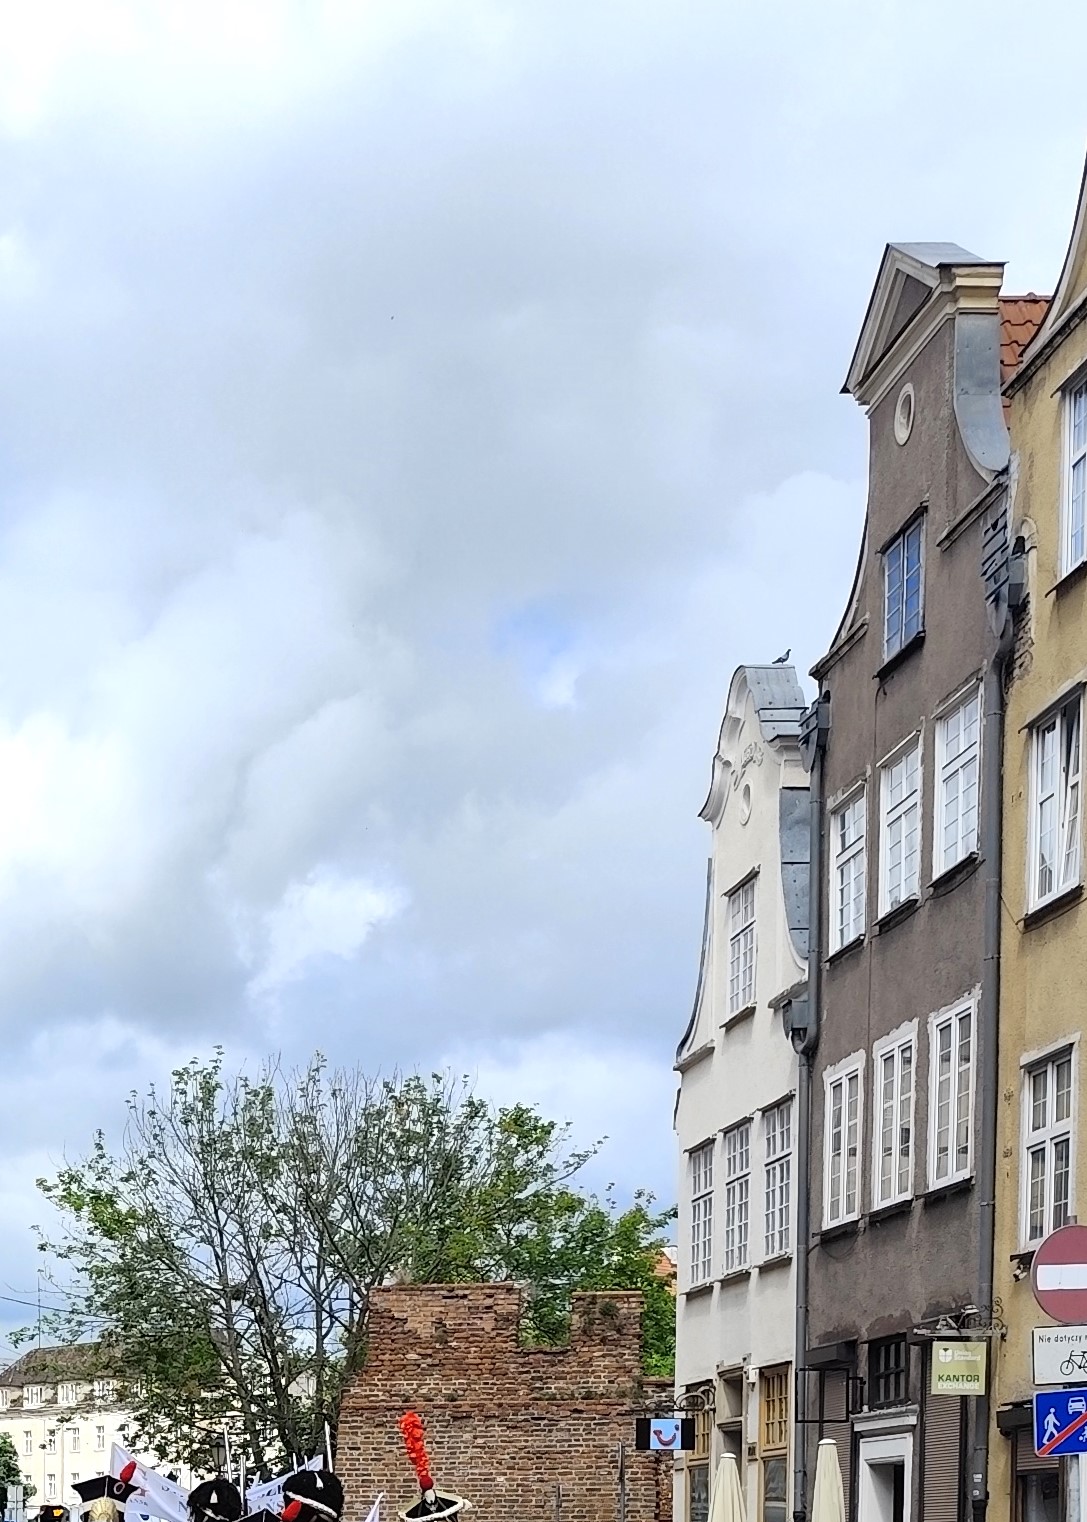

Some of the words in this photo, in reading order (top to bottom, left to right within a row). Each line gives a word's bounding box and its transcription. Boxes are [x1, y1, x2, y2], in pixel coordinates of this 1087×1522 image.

[1038, 1334, 1052, 1344] Nie
[1054, 1334, 1083, 1344] dotyczy
[937, 1374, 980, 1383] KANTOR
[937, 1382, 980, 1390] EXCHANGE
